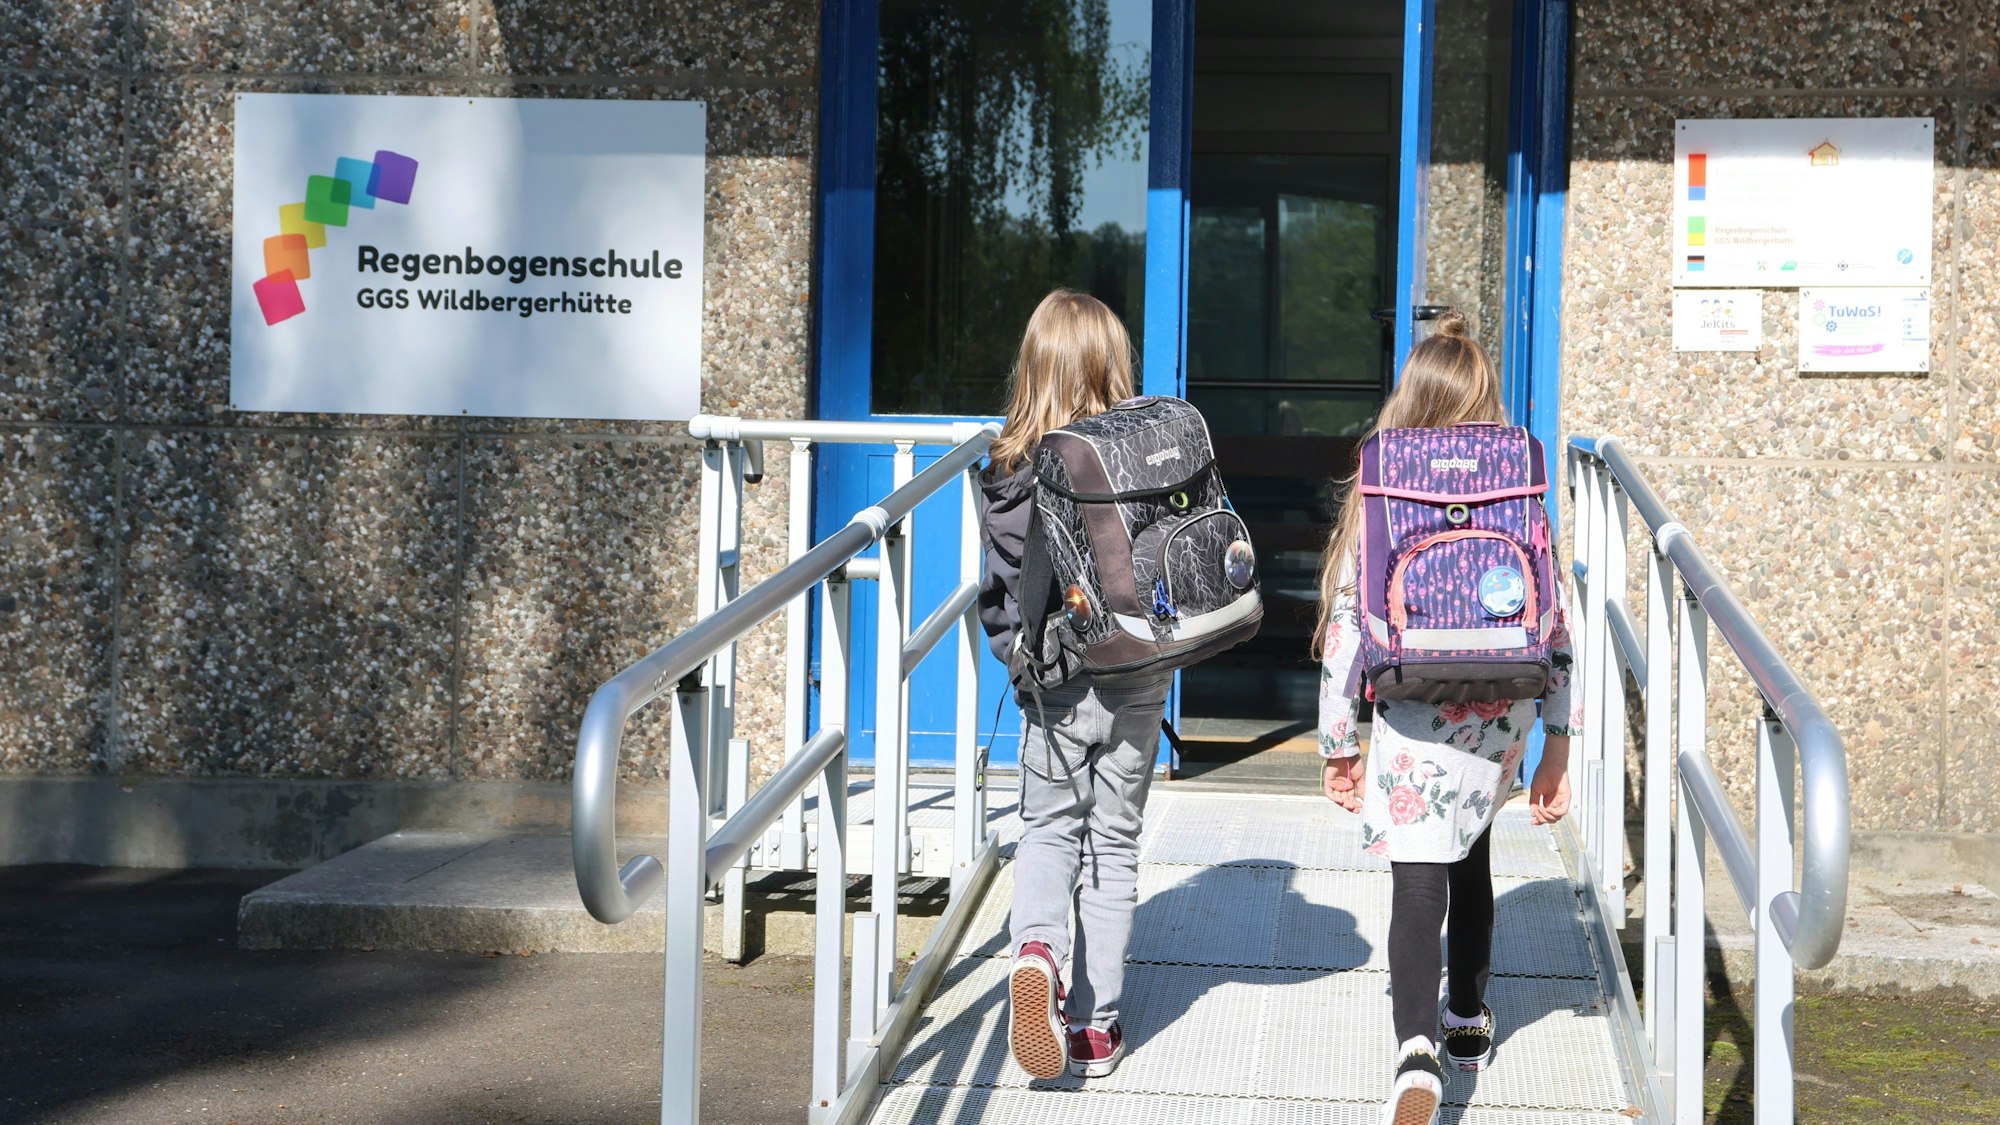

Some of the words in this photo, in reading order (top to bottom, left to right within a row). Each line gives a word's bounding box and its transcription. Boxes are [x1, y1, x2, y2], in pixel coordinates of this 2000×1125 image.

[1715, 226, 1787, 235] Regenbogenschule
[358, 245, 683, 283] Regenbogenschule
[357, 288, 409, 309] GGS
[417, 288, 632, 317] Wildbergerhütte
[1829, 305, 1881, 318] TuWaS!
[1700, 319, 1736, 329] JeKits
[1145, 445, 1180, 466] ergobag
[1430, 457, 1479, 472] ergobag
